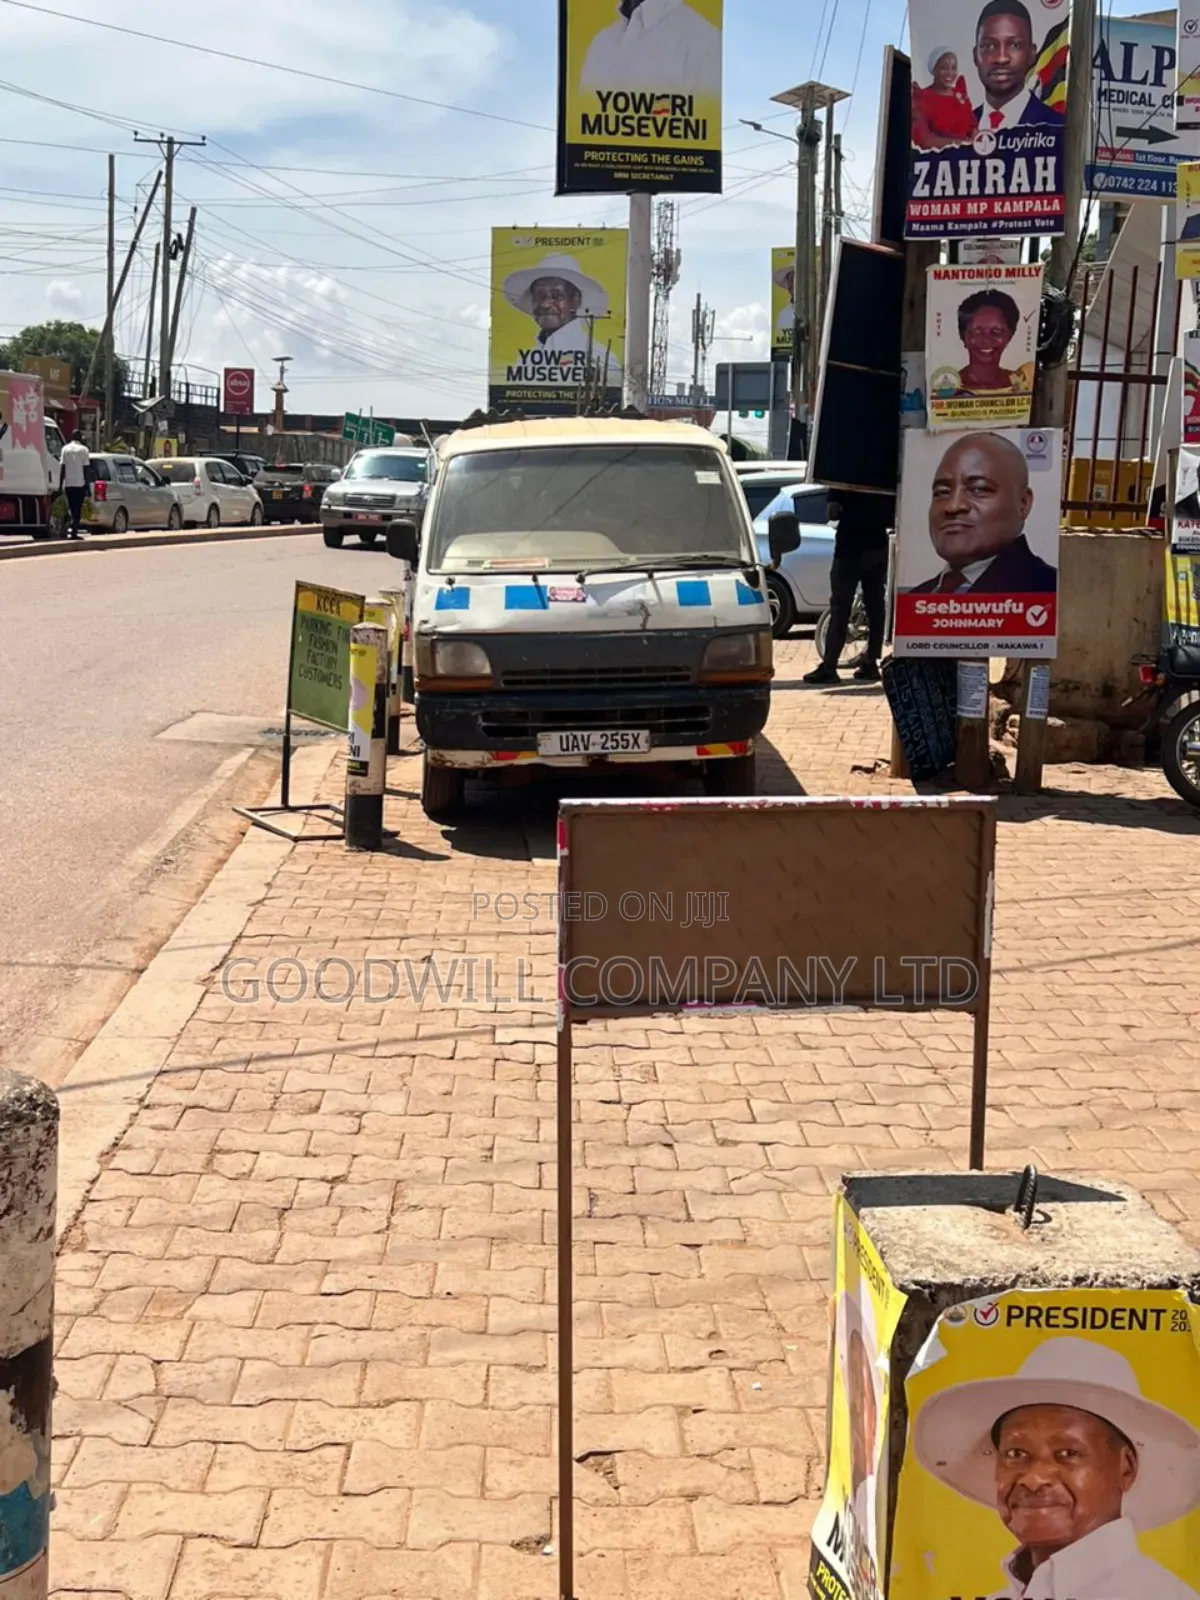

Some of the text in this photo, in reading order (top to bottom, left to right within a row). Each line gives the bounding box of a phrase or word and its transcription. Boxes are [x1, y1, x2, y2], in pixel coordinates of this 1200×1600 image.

[596, 90, 693, 117] YOWERI
[1098, 87, 1156, 108] MEDICAL
[581, 113, 707, 140] MUSEVENI
[998, 132, 1056, 152] Luyirika
[584, 151, 705, 166] PROTECTING THE GAINS
[912, 156, 1056, 197] ZAHRAH
[1108, 175, 1136, 190] 0742
[1137, 178, 1158, 191] 224
[909, 199, 1061, 216] WOMAN MP KAMPALA
[912, 218, 1055, 232] Maama Kampala #Protest Vote
[535, 237, 591, 246] PRESIDENT
[933, 265, 1041, 280] NANTONGO MILLY
[519, 349, 588, 366] YOWER
[505, 390, 557, 399] PROTECTING
[915, 599, 1024, 614] Ssebuwufu
[932, 618, 1004, 628] JOHNMARY
[906, 642, 930, 650] LORD
[933, 642, 989, 650] COUNCILLOR
[299, 663, 343, 691] CUSTOMERS
[560, 732, 641, 752] UAV 255X
[1006, 1304, 1167, 1331] PRESIDENT
